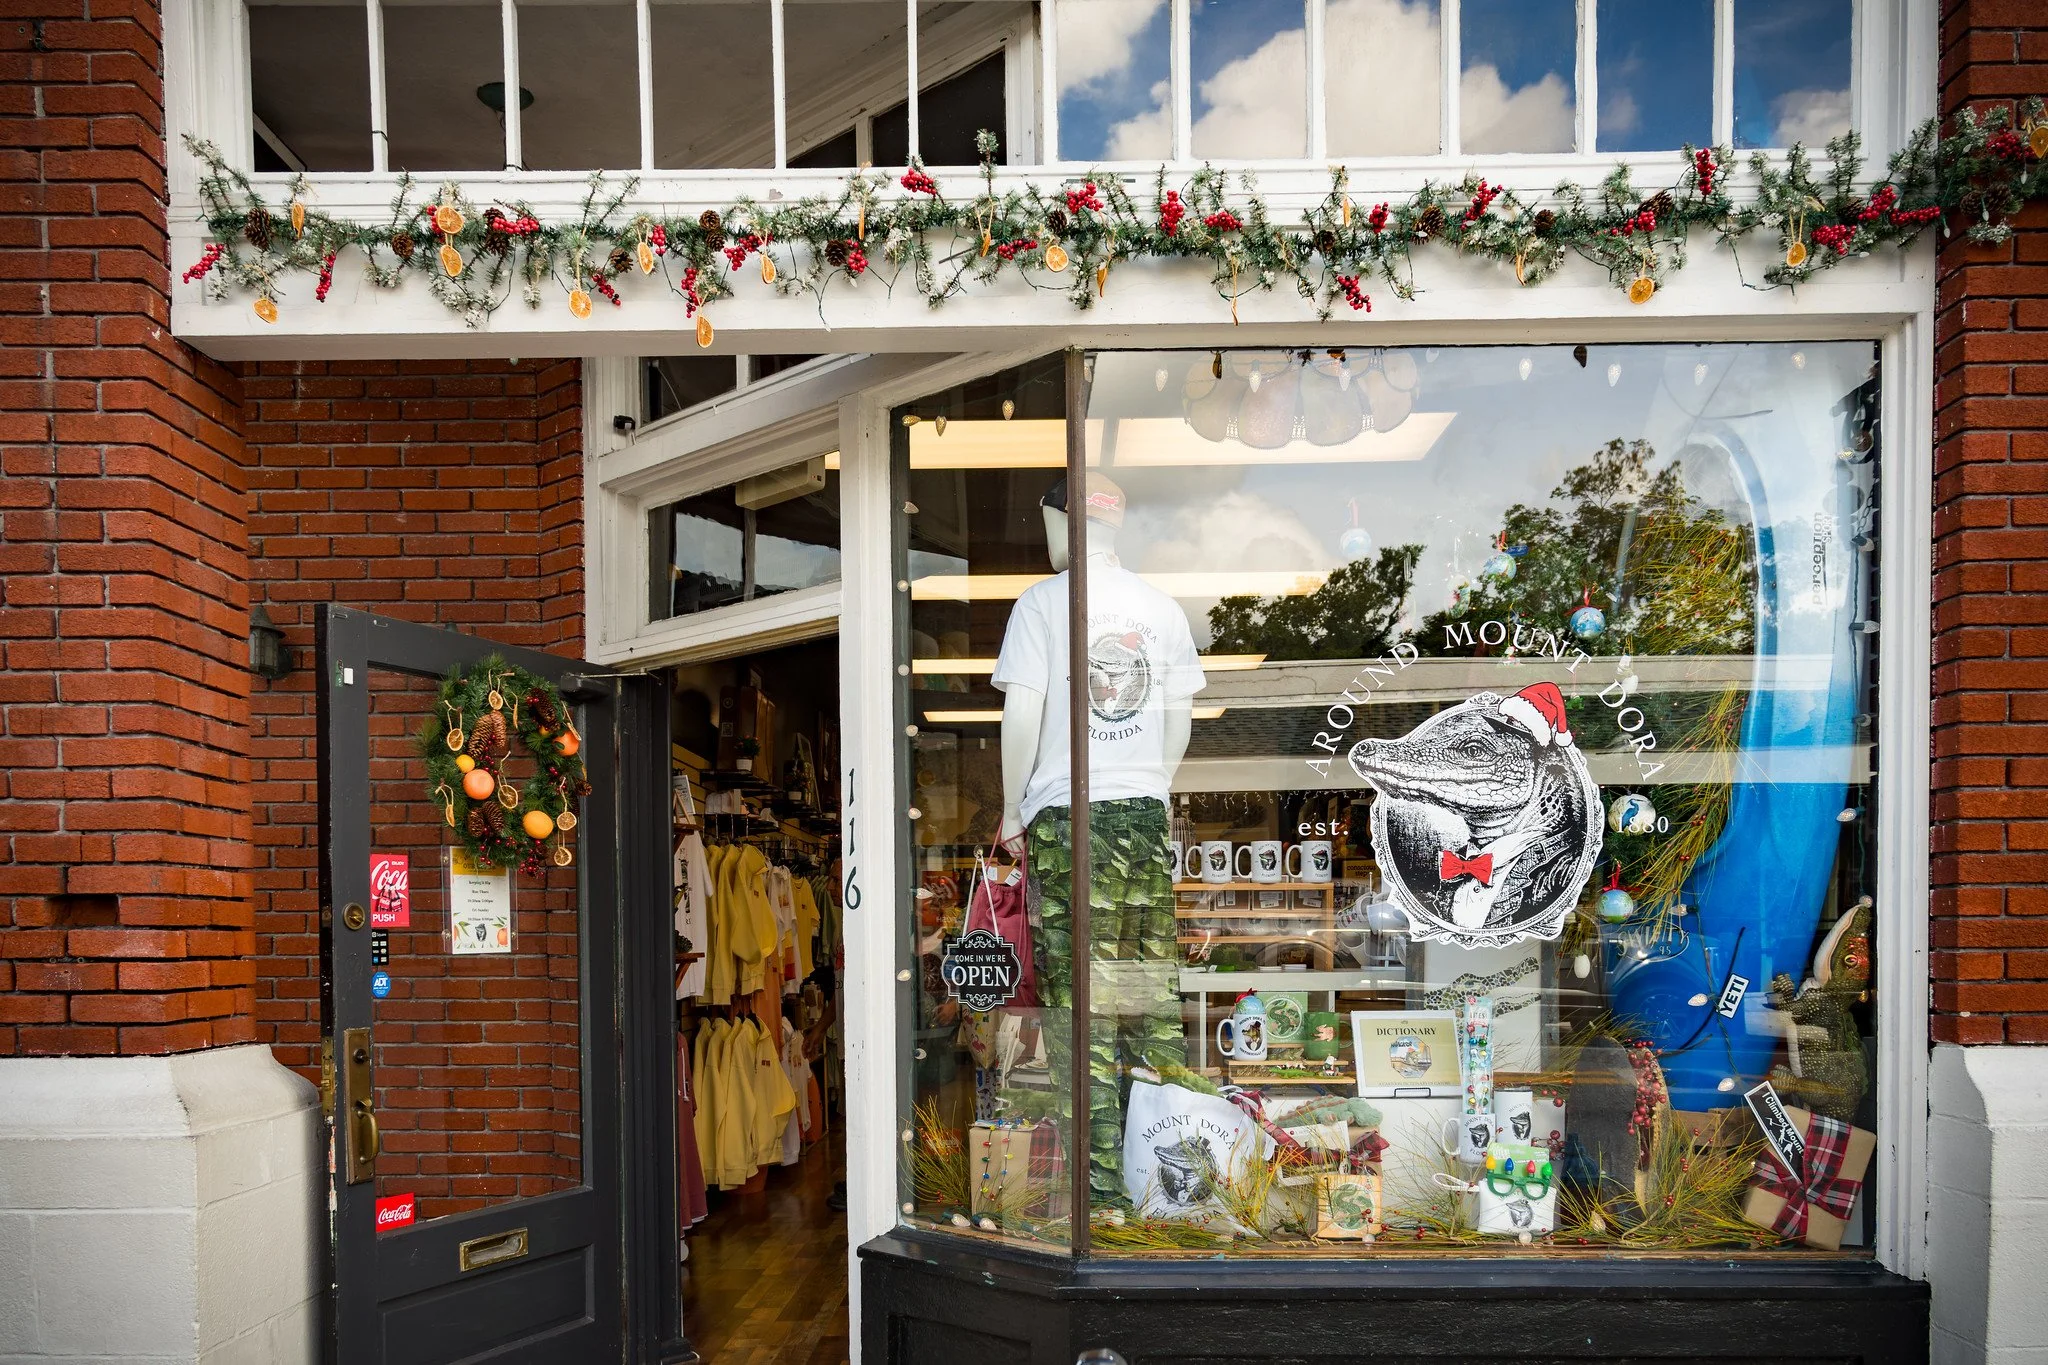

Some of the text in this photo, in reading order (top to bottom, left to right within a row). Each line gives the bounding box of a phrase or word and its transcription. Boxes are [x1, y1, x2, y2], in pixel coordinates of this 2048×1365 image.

[1087, 613, 1158, 644] OUNT DORA
[1305, 620, 1666, 781] AROUND MOUNT DORA
[1298, 819, 1349, 836] est.
[1617, 816, 1669, 834] 1880
[845, 768, 862, 910] 116
[371, 860, 408, 891] Coca
[372, 913, 396, 922] PUSH
[955, 954, 1006, 962] COME IN WE'RE
[374, 977, 388, 987] ADT
[951, 965, 1011, 986] OPEN
[1720, 978, 1746, 1013] YETI
[1376, 1028, 1436, 1036] DICTIONARY
[1142, 1114, 1236, 1150] MOUNT DORA
[1765, 1096, 1790, 1128] Climbed
[1786, 1127, 1804, 1154] Mount
[378, 1203, 413, 1224] Coca-Cola
